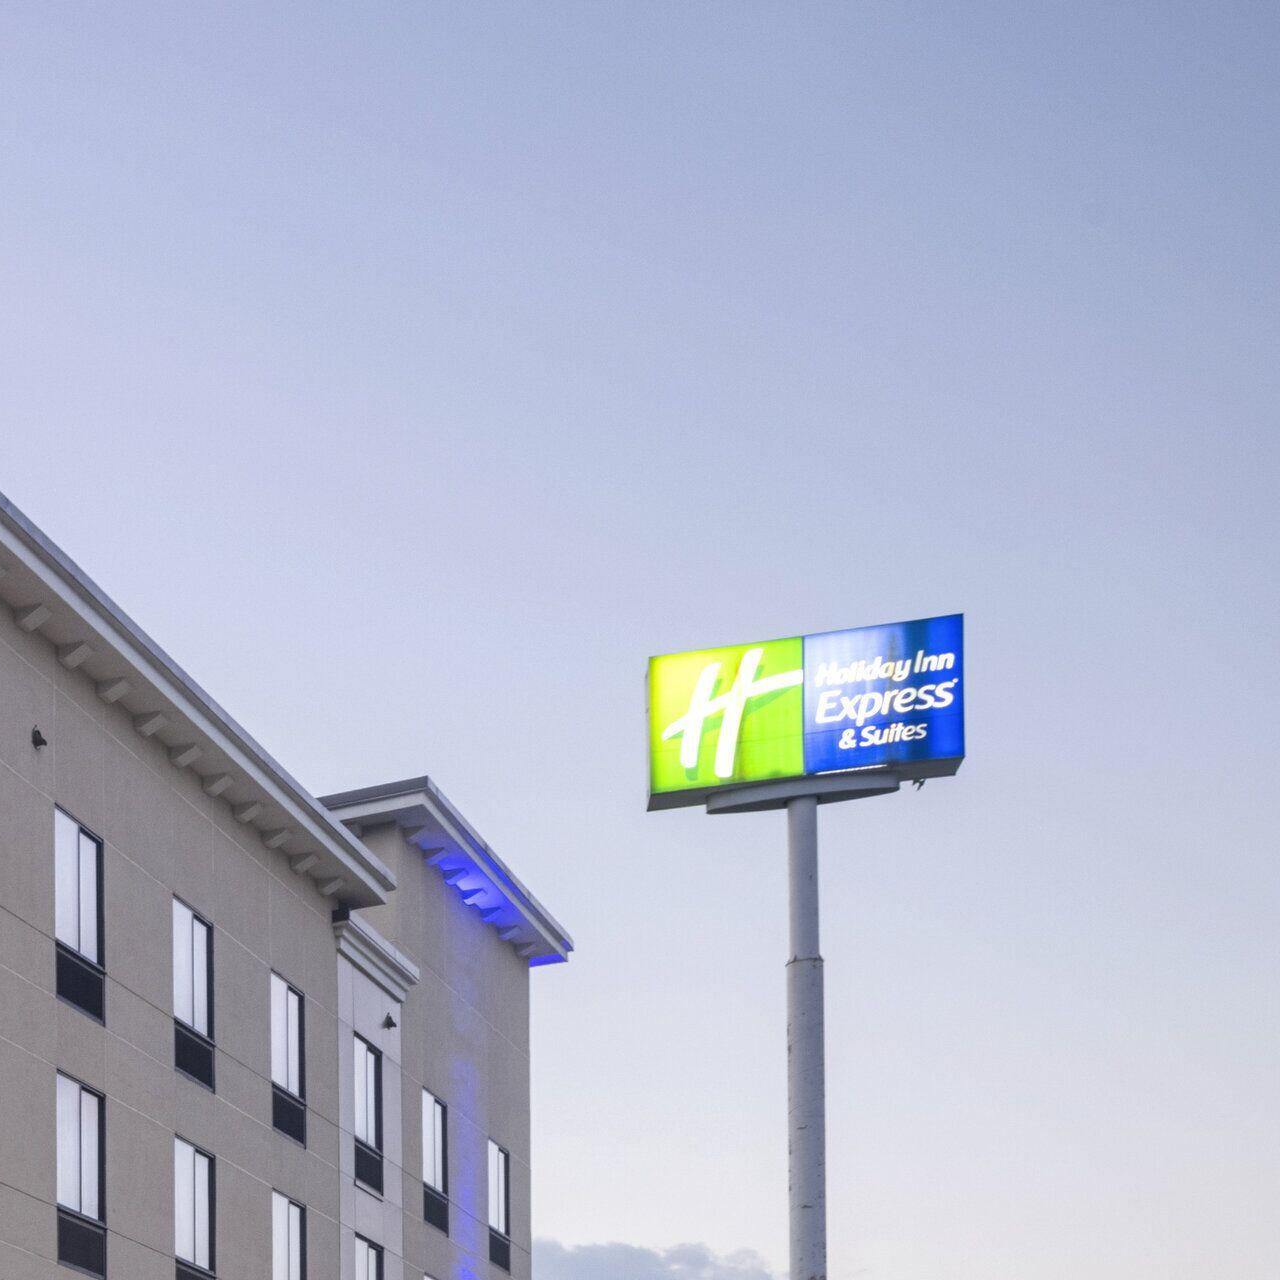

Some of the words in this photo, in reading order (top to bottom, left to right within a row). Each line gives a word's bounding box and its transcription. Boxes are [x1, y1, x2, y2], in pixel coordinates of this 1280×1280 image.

[815, 656, 911, 687] Holiday
[914, 650, 955, 673] Inn
[815, 680, 956, 727] Express
[838, 729, 856, 750] &
[859, 722, 928, 748] Suites
